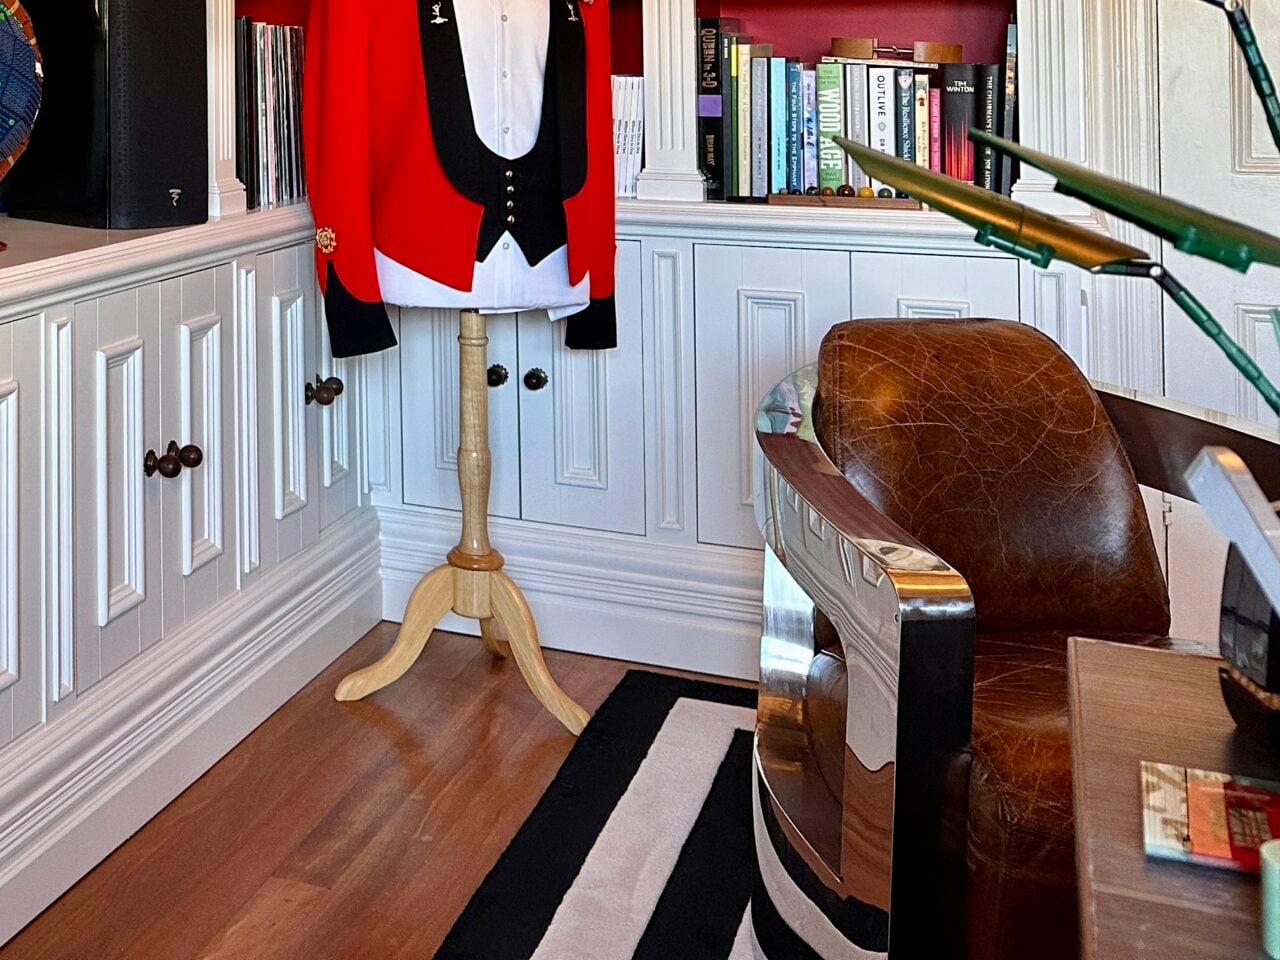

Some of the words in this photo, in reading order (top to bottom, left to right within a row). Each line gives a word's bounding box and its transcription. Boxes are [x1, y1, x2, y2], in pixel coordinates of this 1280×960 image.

[700, 28, 718, 62] QUEEN
[701, 72, 718, 88] 3-D
[877, 75, 886, 117] OUTLIVE
[818, 88, 841, 132] WOOD
[901, 92, 910, 104] The
[985, 90, 993, 128] CHAIRMAN'S
[791, 133, 798, 142] TO
[901, 106, 911, 139] Resilience
[819, 136, 842, 170] AGE
[902, 140, 912, 162] Shield
